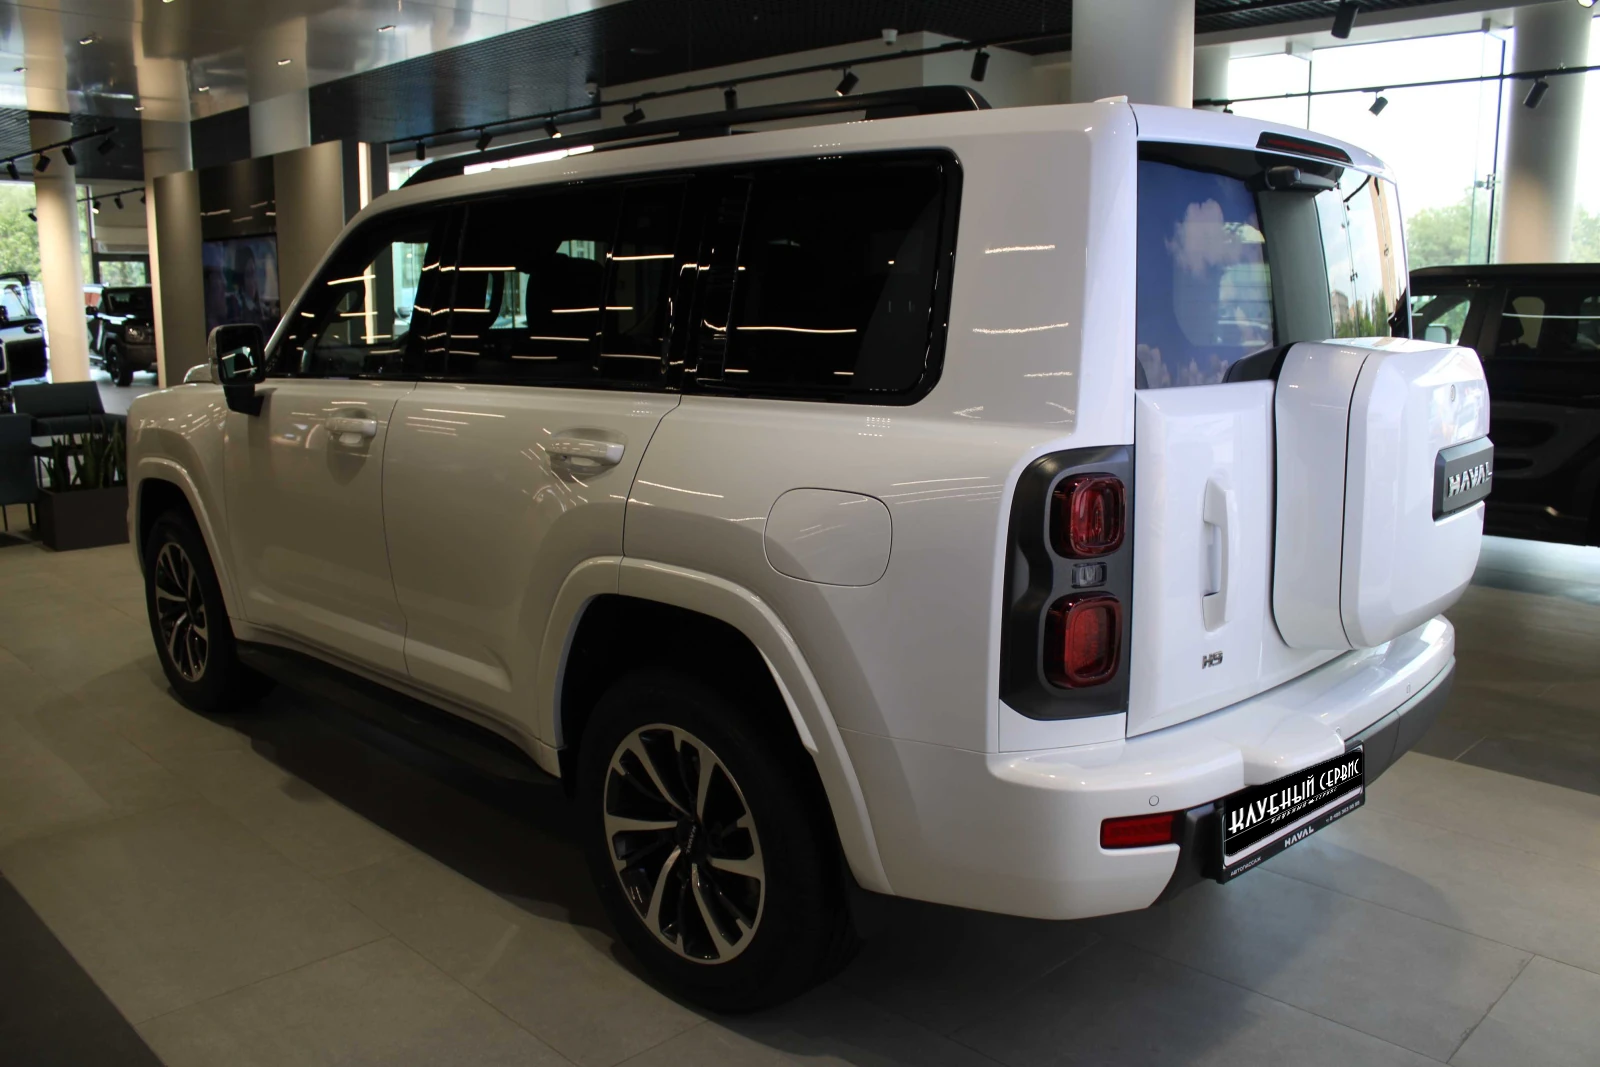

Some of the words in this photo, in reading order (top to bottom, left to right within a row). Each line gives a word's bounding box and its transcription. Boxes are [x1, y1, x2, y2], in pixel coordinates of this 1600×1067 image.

[1448, 461, 1493, 498] HAVAL
[1202, 650, 1223, 670] H9
[1284, 826, 1315, 848] HAVAL
